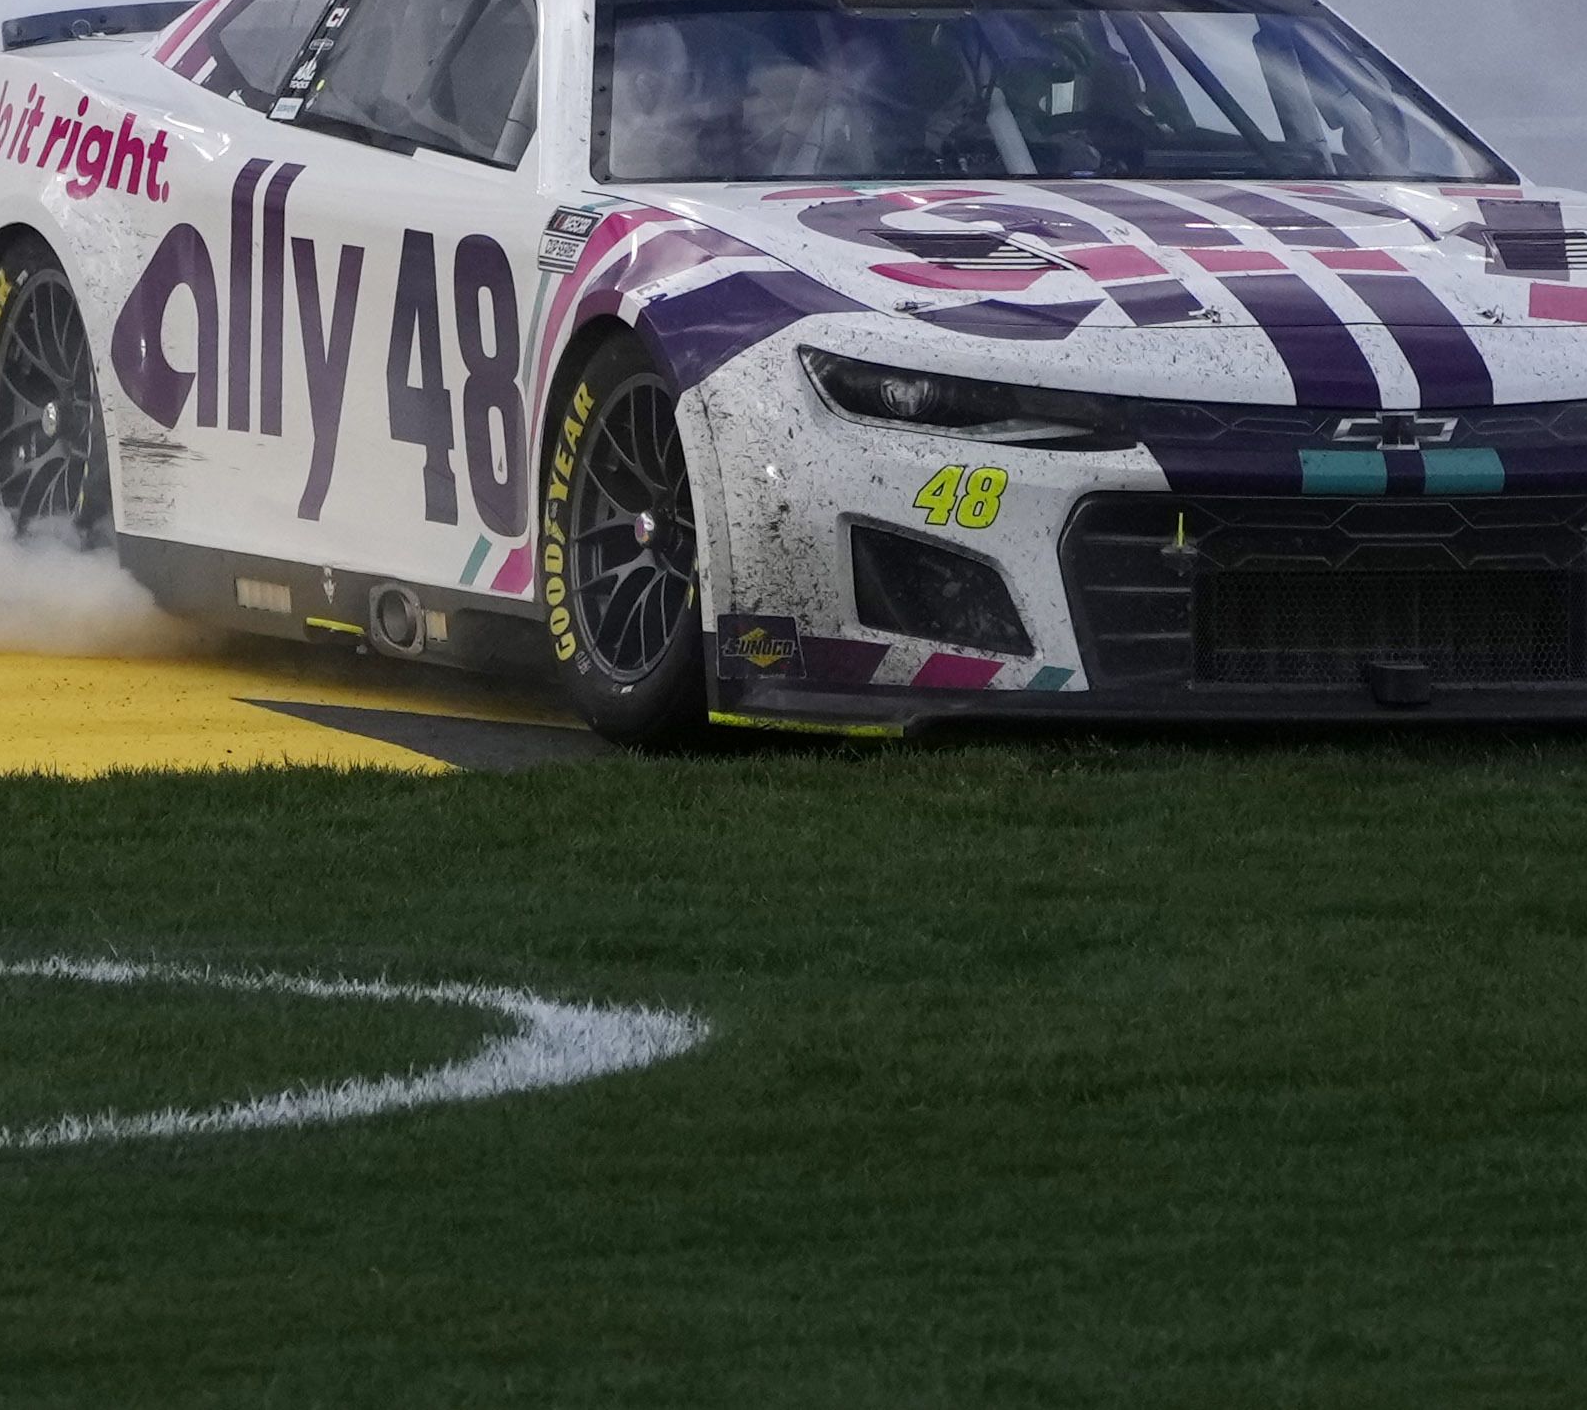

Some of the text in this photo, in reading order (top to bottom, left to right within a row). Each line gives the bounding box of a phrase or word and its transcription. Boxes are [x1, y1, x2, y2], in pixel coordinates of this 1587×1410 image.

[7, 83, 45, 165] it
[36, 95, 170, 203] right.
[111, 157, 365, 522] ally
[387, 228, 529, 538] 48
[544, 382, 596, 661] GOODYEAR
[912, 464, 1009, 530] 48
